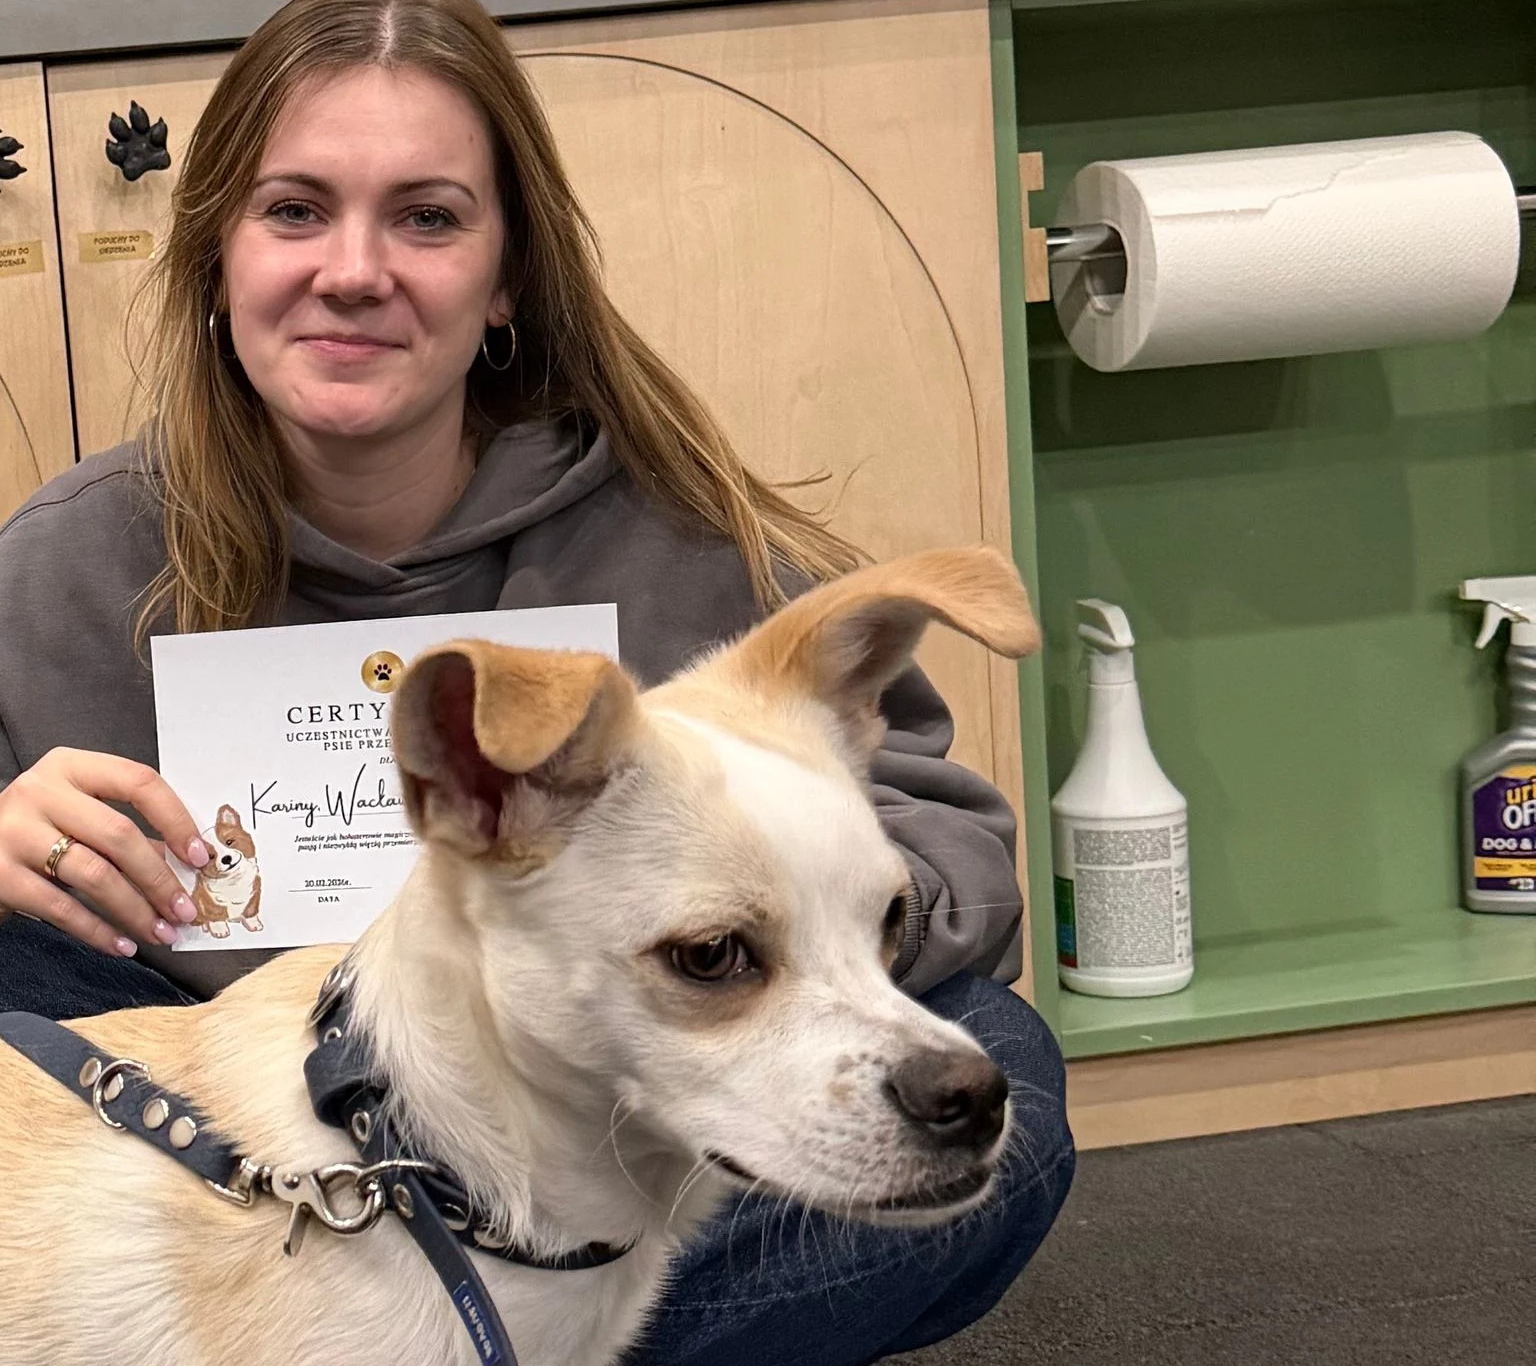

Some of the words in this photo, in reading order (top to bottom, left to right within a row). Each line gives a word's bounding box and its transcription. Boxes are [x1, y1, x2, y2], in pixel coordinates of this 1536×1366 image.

[287, 702, 387, 724] CERTY
[323, 741, 353, 751] PSIE
[358, 738, 392, 749] PRZE
[325, 763, 404, 826] Wacła
[1502, 800, 1536, 830] OF
[1482, 837, 1518, 851] DOG
